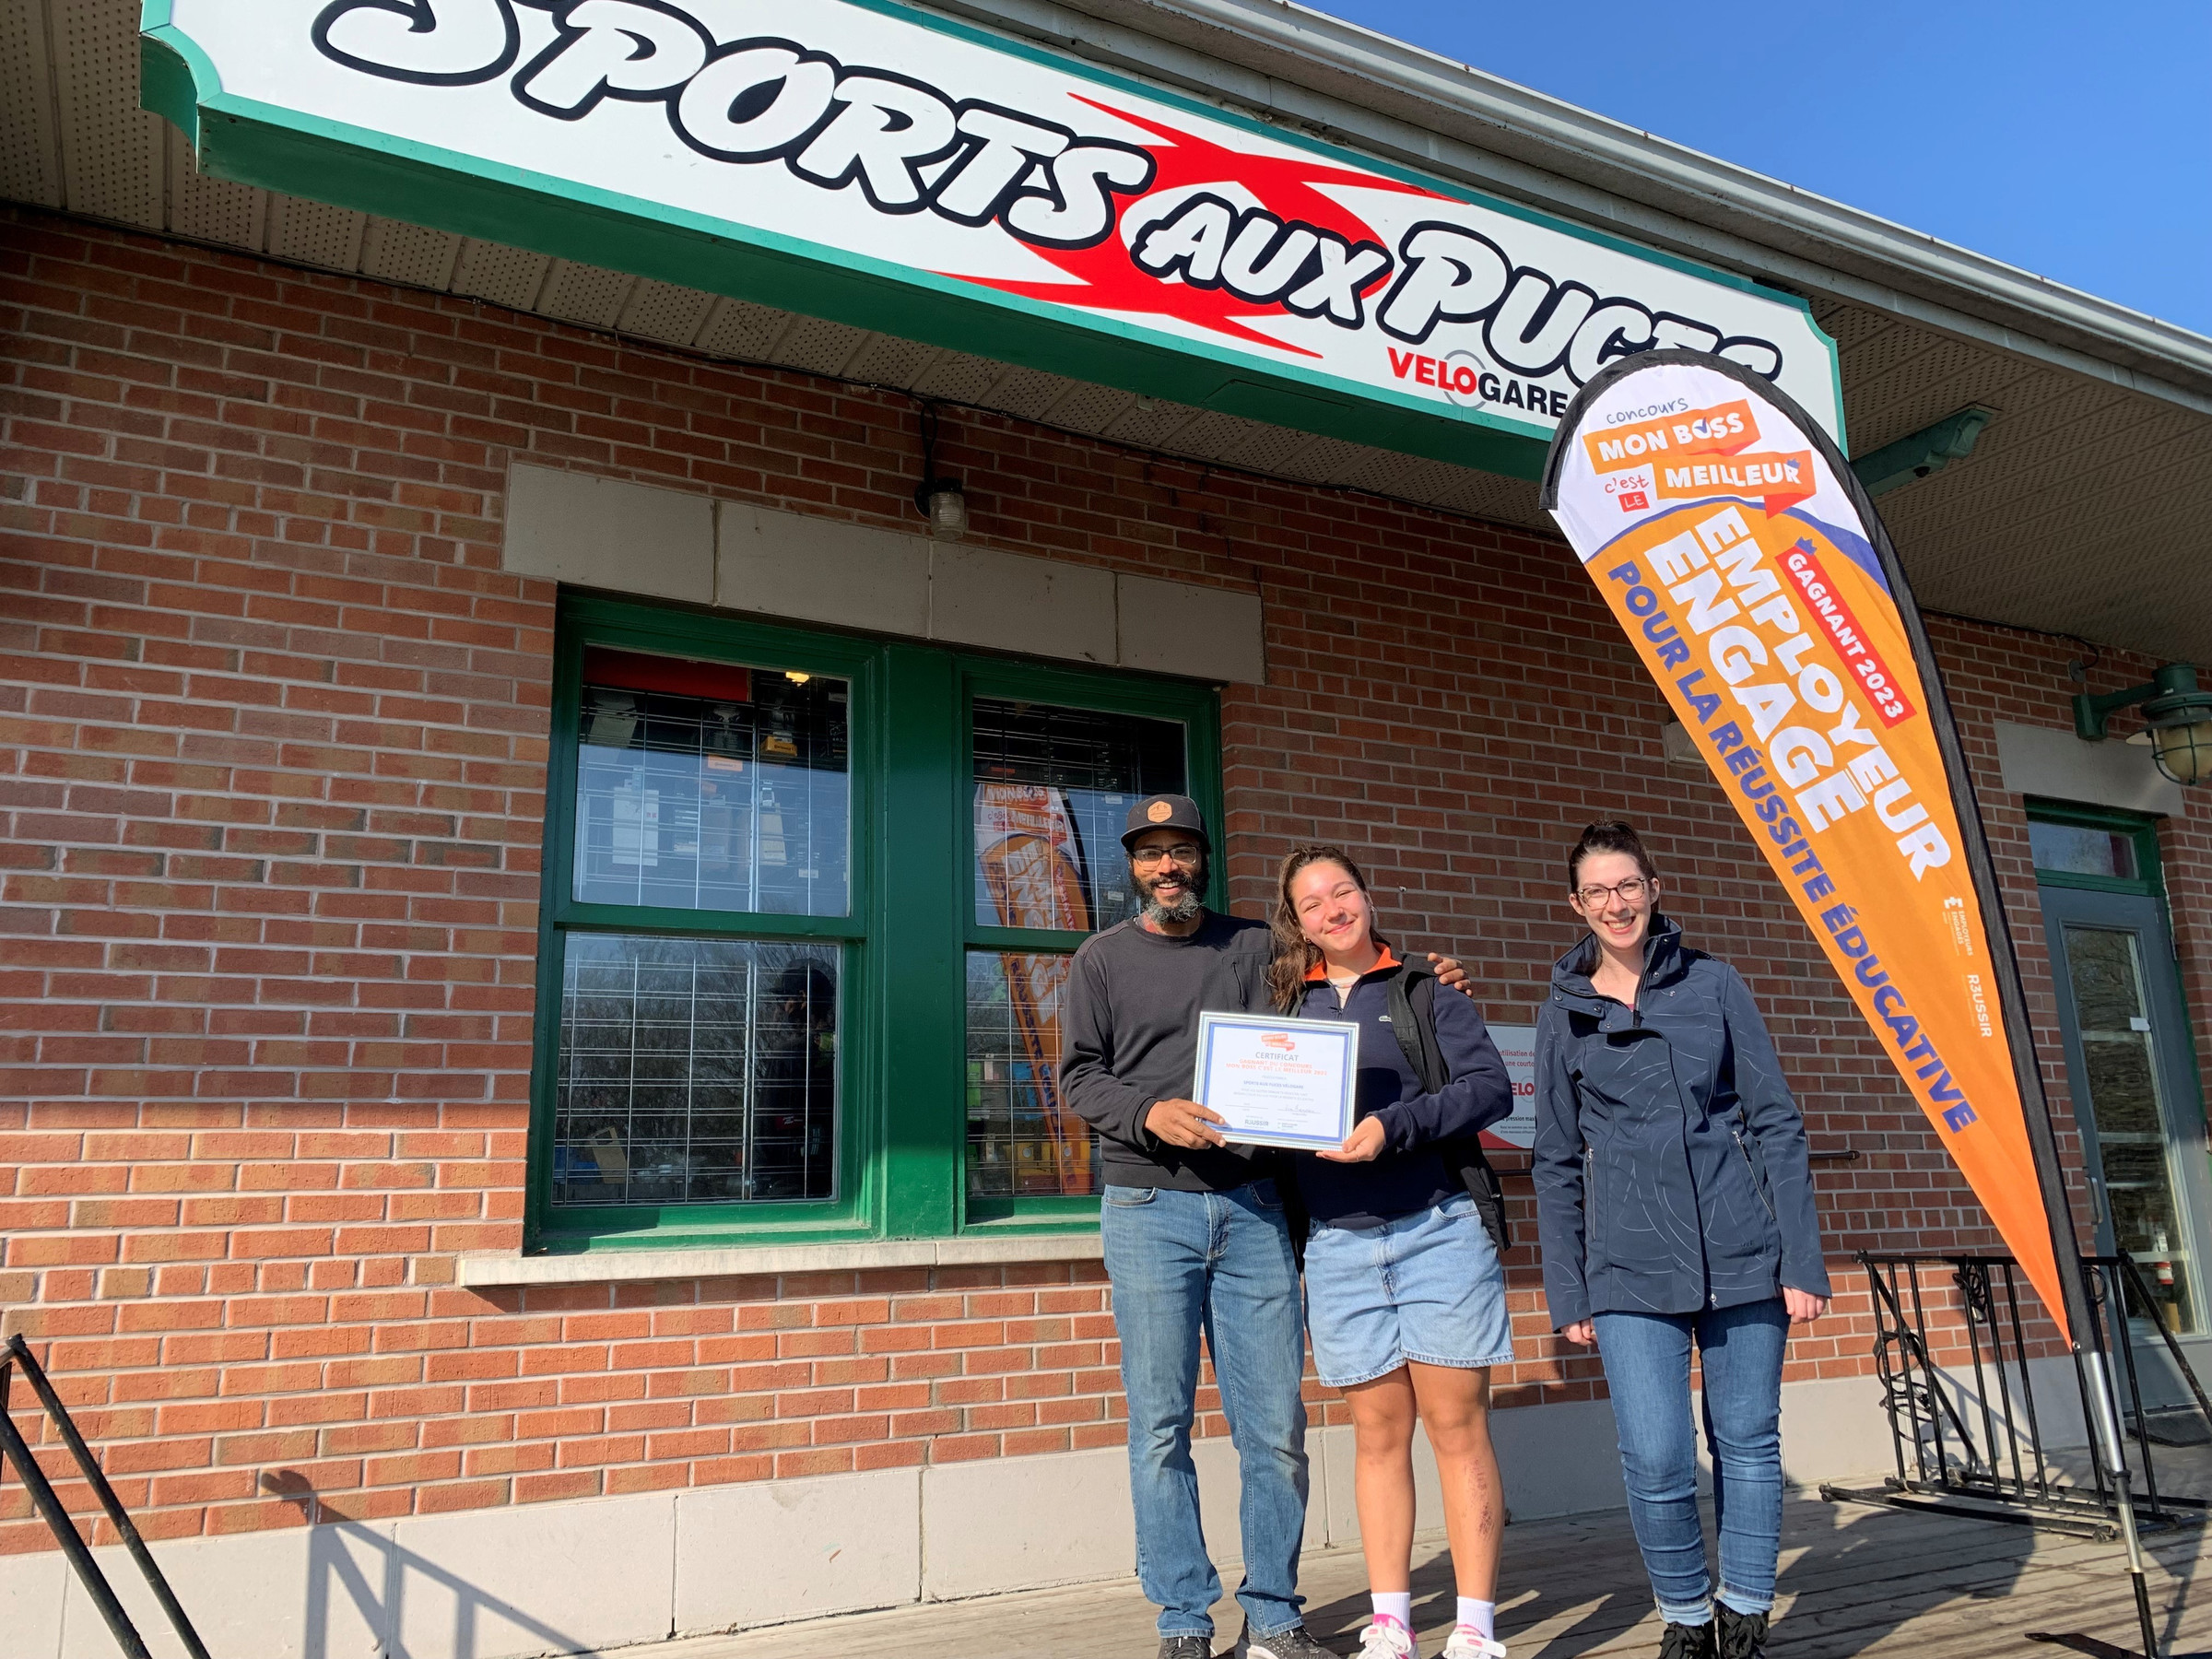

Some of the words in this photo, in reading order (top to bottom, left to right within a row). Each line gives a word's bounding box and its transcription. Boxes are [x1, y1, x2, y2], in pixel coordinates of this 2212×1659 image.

[1130, 192, 1394, 329] AUX
[1606, 396, 1688, 425] concours
[1598, 429, 1668, 462] MON
[1672, 412, 1745, 444] BOSS
[1605, 474, 1649, 494] c'est
[1665, 462, 1801, 488] MEILLEUR
[1624, 494, 1643, 508] LE
[1787, 553, 1865, 657] GAGNANT
[1856, 659, 1904, 718] 2023
[1695, 506, 1951, 882] EMPLOYEUR
[1607, 560, 1690, 672] POUR
[1676, 667, 1723, 725] LA
[1709, 720, 1835, 903] RÉUSSITE
[1820, 902, 1978, 1134] ÉDUCATIVE
[1255, 1052, 1300, 1062] CERTIFICAT
